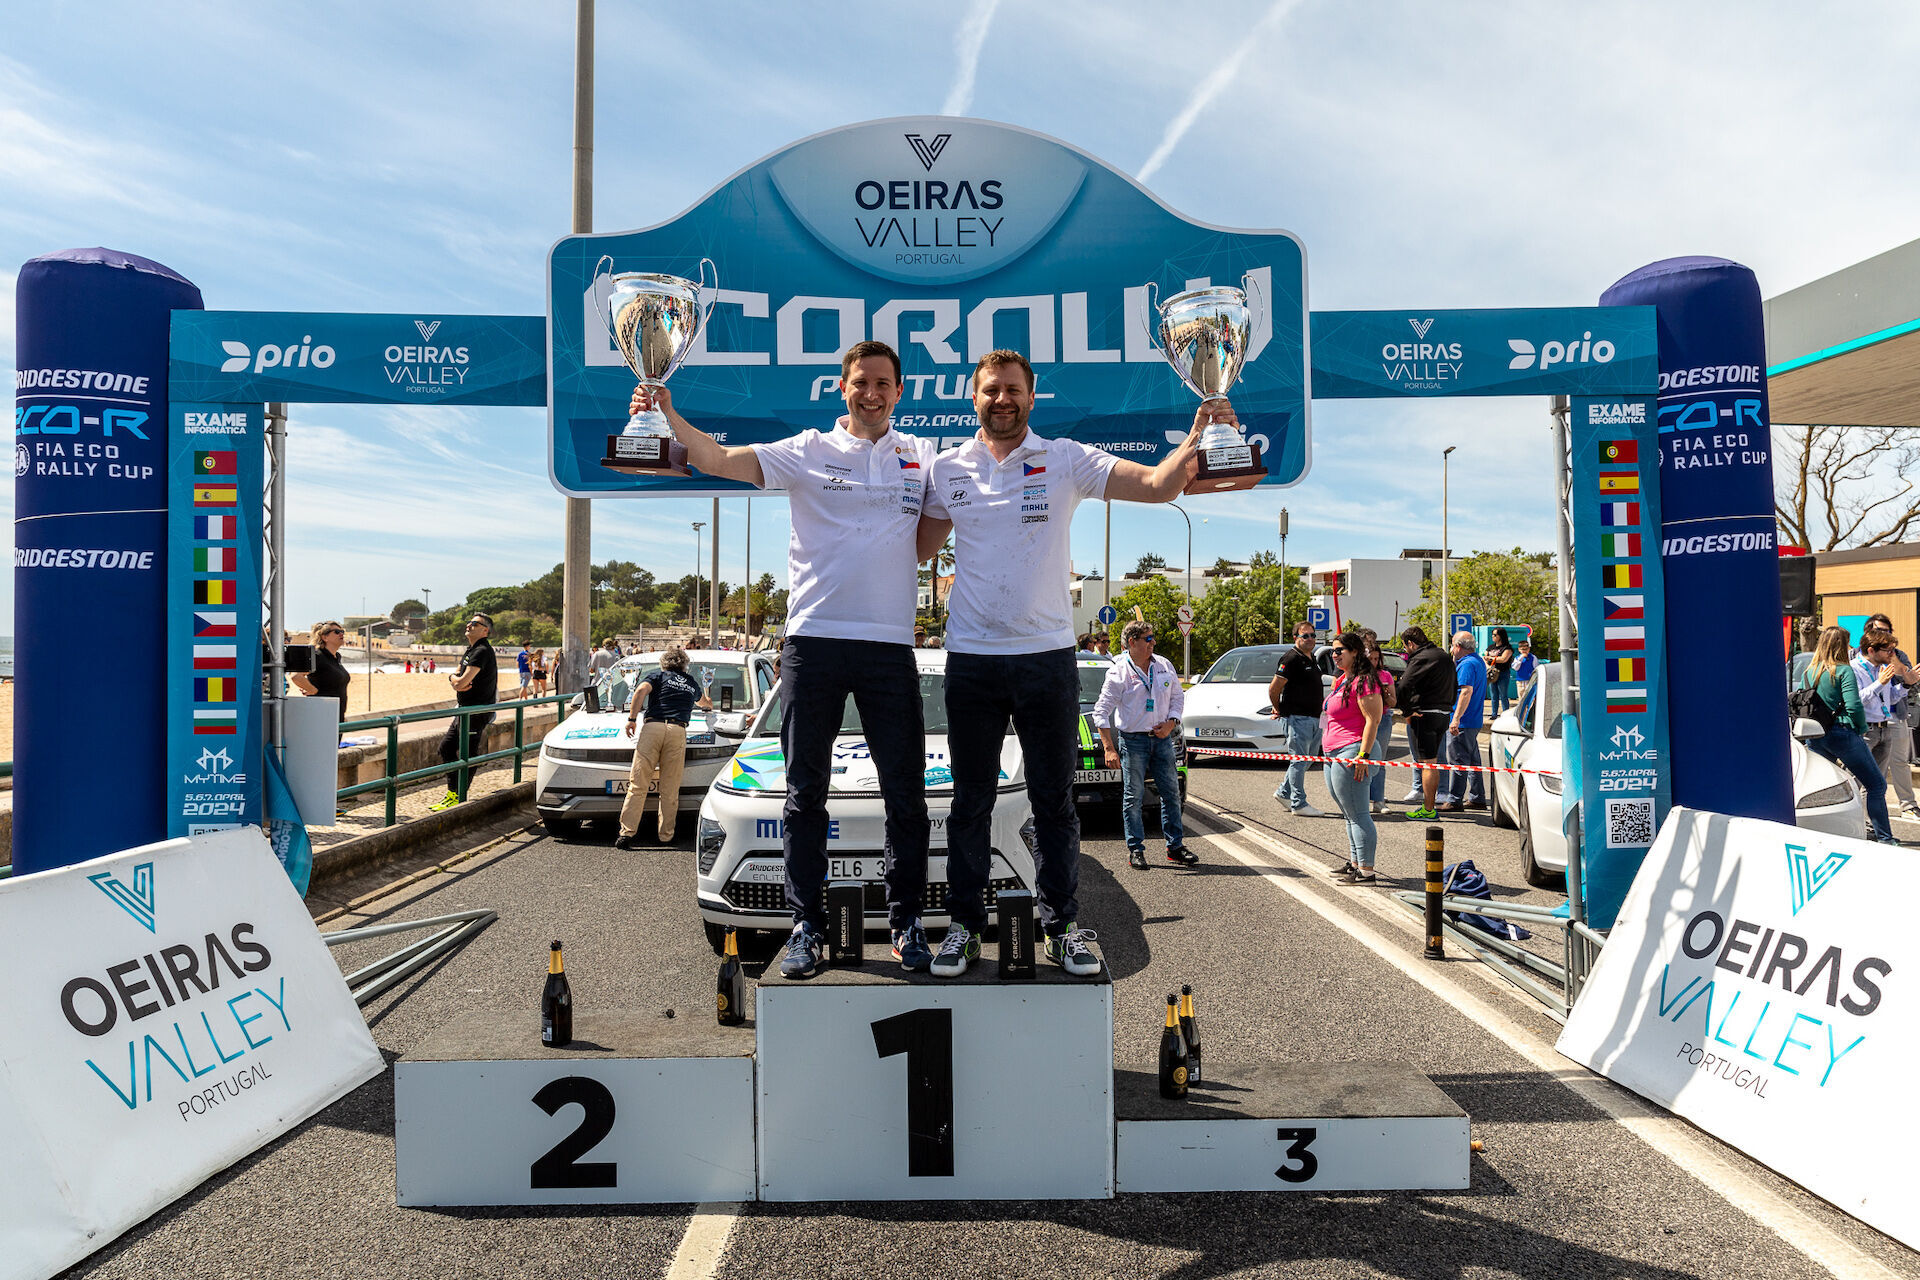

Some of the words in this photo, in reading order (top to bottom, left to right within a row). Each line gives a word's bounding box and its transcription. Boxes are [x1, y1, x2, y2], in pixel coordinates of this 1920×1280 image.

[855, 180, 1004, 210] OEIRAS
[855, 217, 1004, 247] VALLEY
[895, 253, 965, 265] PORTUGAL
[254, 335, 336, 373] prio
[384, 346, 470, 364] OEIRAS
[1382, 343, 1463, 361] OEIRAS
[1540, 330, 1616, 370] prio
[384, 366, 470, 385] VALLEY
[1382, 363, 1463, 381] VALLEY
[1658, 365, 1760, 391] DGESTONE
[406, 386, 446, 394] PORTUGAL
[810, 375, 1056, 401] PTUL
[184, 413, 247, 426] EXAME
[1588, 403, 1646, 417] EXAME
[1658, 399, 1763, 434] CO-R
[36, 443, 66, 457] FIA
[74, 444, 120, 459] ECO
[1672, 437, 1706, 452] FIA
[1713, 434, 1748, 448] ECO
[1674, 452, 1734, 470] RALLY
[1741, 451, 1767, 465] CUP
[36, 462, 98, 477] RALLY
[108, 464, 153, 480] CUP
[1662, 532, 1773, 557] IDGESTONE
[1312, 611, 1325, 627] P
[1456, 616, 1468, 632] P
[1600, 749, 1657, 761] MYTIME
[184, 773, 246, 783] MYTIME
[1599, 777, 1658, 791] 2024
[182, 802, 246, 816] 2024
[752, 873, 785, 881] ENLITE
[831, 860, 862, 877] EL6
[1681, 910, 1893, 1017] OEIRAS
[60, 922, 272, 1037] OEIRAS
[1659, 964, 1866, 1087] VALLEY
[85, 977, 291, 1110] VALLEY
[1676, 1042, 1769, 1099] PORTUGAL
[177, 1062, 273, 1123] PORTUGAL
[870, 1007, 955, 1178] 1
[529, 1074, 618, 1190] 2
[1274, 1127, 1319, 1185] 3
